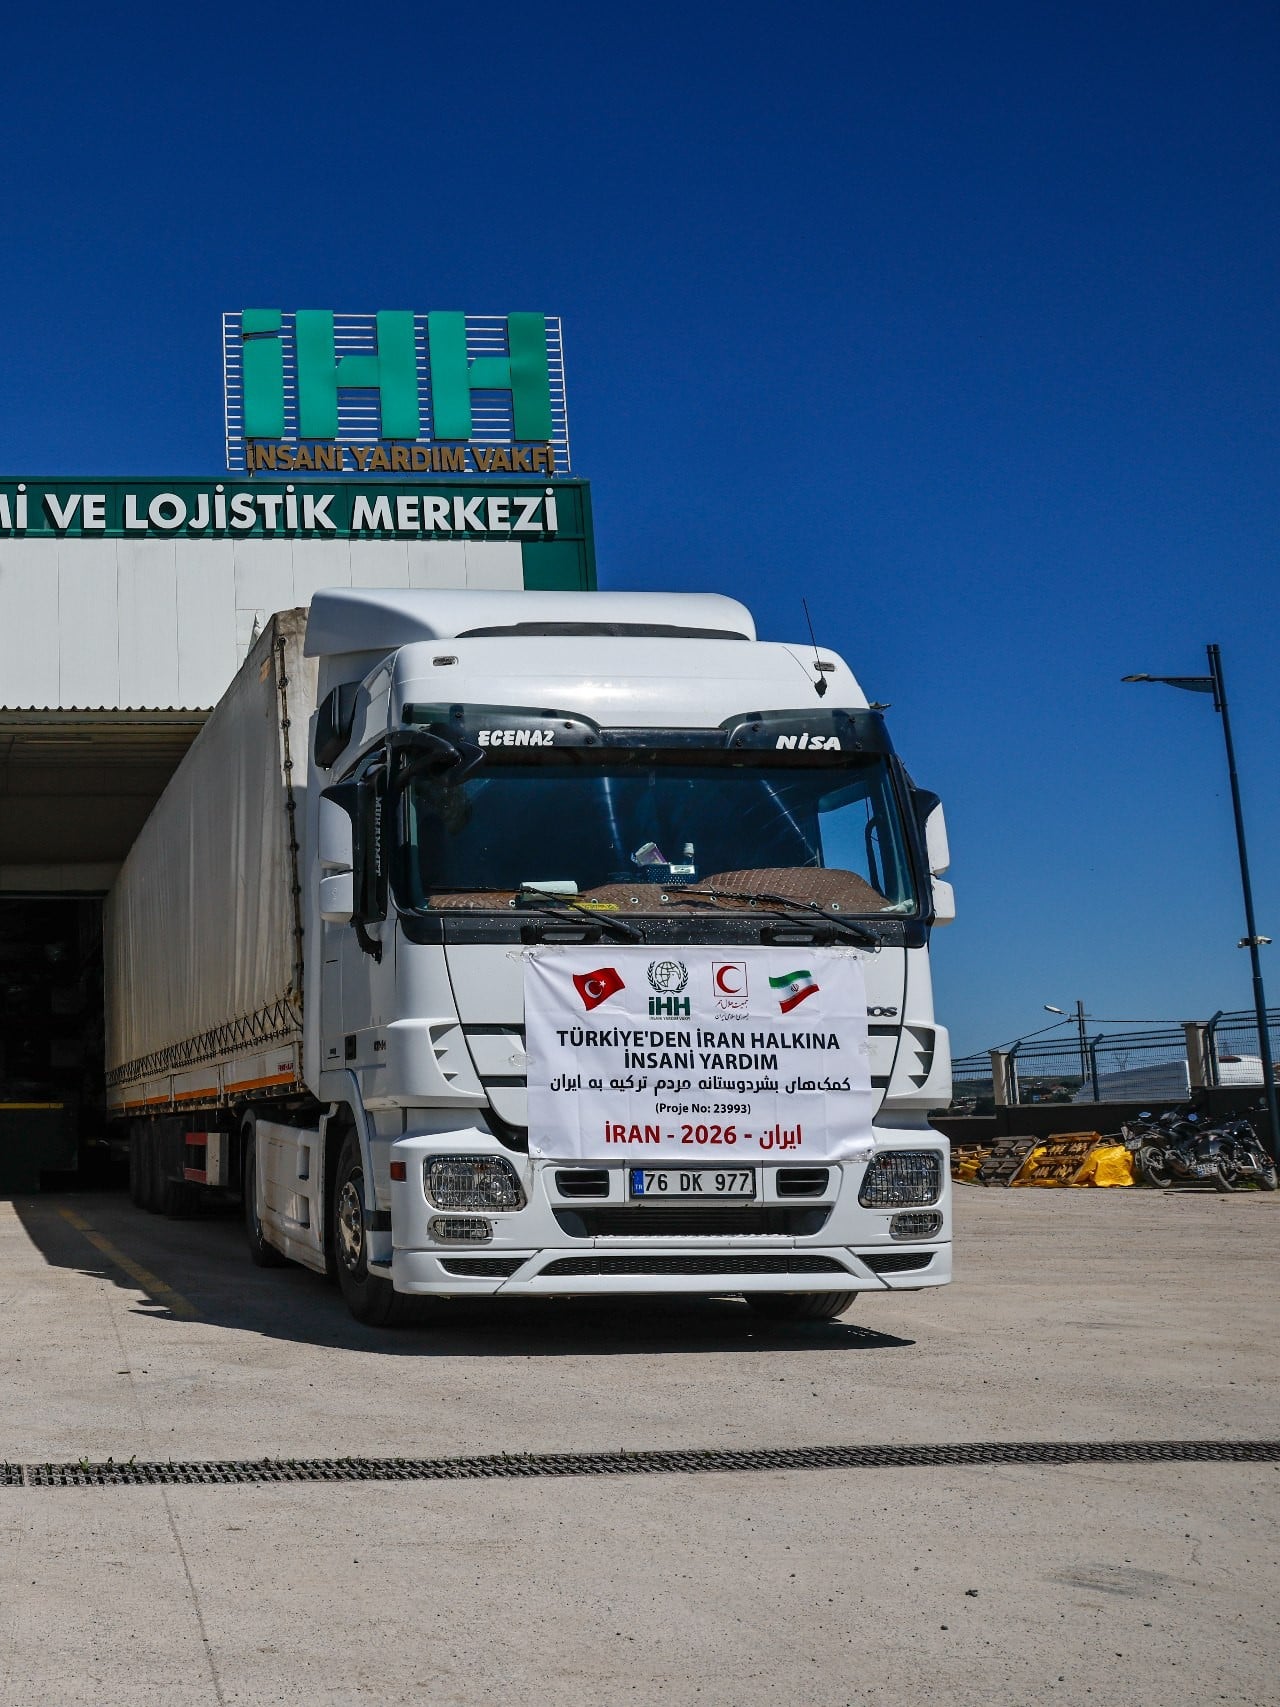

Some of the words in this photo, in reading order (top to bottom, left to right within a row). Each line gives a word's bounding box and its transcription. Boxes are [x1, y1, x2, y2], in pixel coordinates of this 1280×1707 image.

[350, 446, 465, 471] YARDIM
[45, 493, 106, 529] VE
[125, 484, 338, 530] LOJİSTİK
[351, 487, 558, 531] MERKEZİ
[556, 1027, 691, 1048] TÜRKİYE'DEN
[697, 1028, 746, 1049] İRAN
[751, 1032, 840, 1050] HALKINA
[624, 1048, 695, 1069] İNSANİ
[699, 1053, 778, 1070] YARDIM
[550, 1073, 581, 1092] ایران
[588, 1078, 603, 1092] به
[609, 1075, 648, 1093] ترکیه
[654, 1079, 692, 1096] مردم
[698, 1075, 779, 1094] بشردوستانه
[655, 1103, 689, 1115] (Proje
[691, 1103, 711, 1113] No:
[713, 1103, 751, 1115] 23993)
[605, 1120, 661, 1144] İRAN
[681, 1125, 737, 1145] 2026
[759, 1124, 802, 1150] ایران
[644, 1173, 668, 1192] 76
[680, 1173, 703, 1192] DK
[715, 1173, 750, 1192] 977
